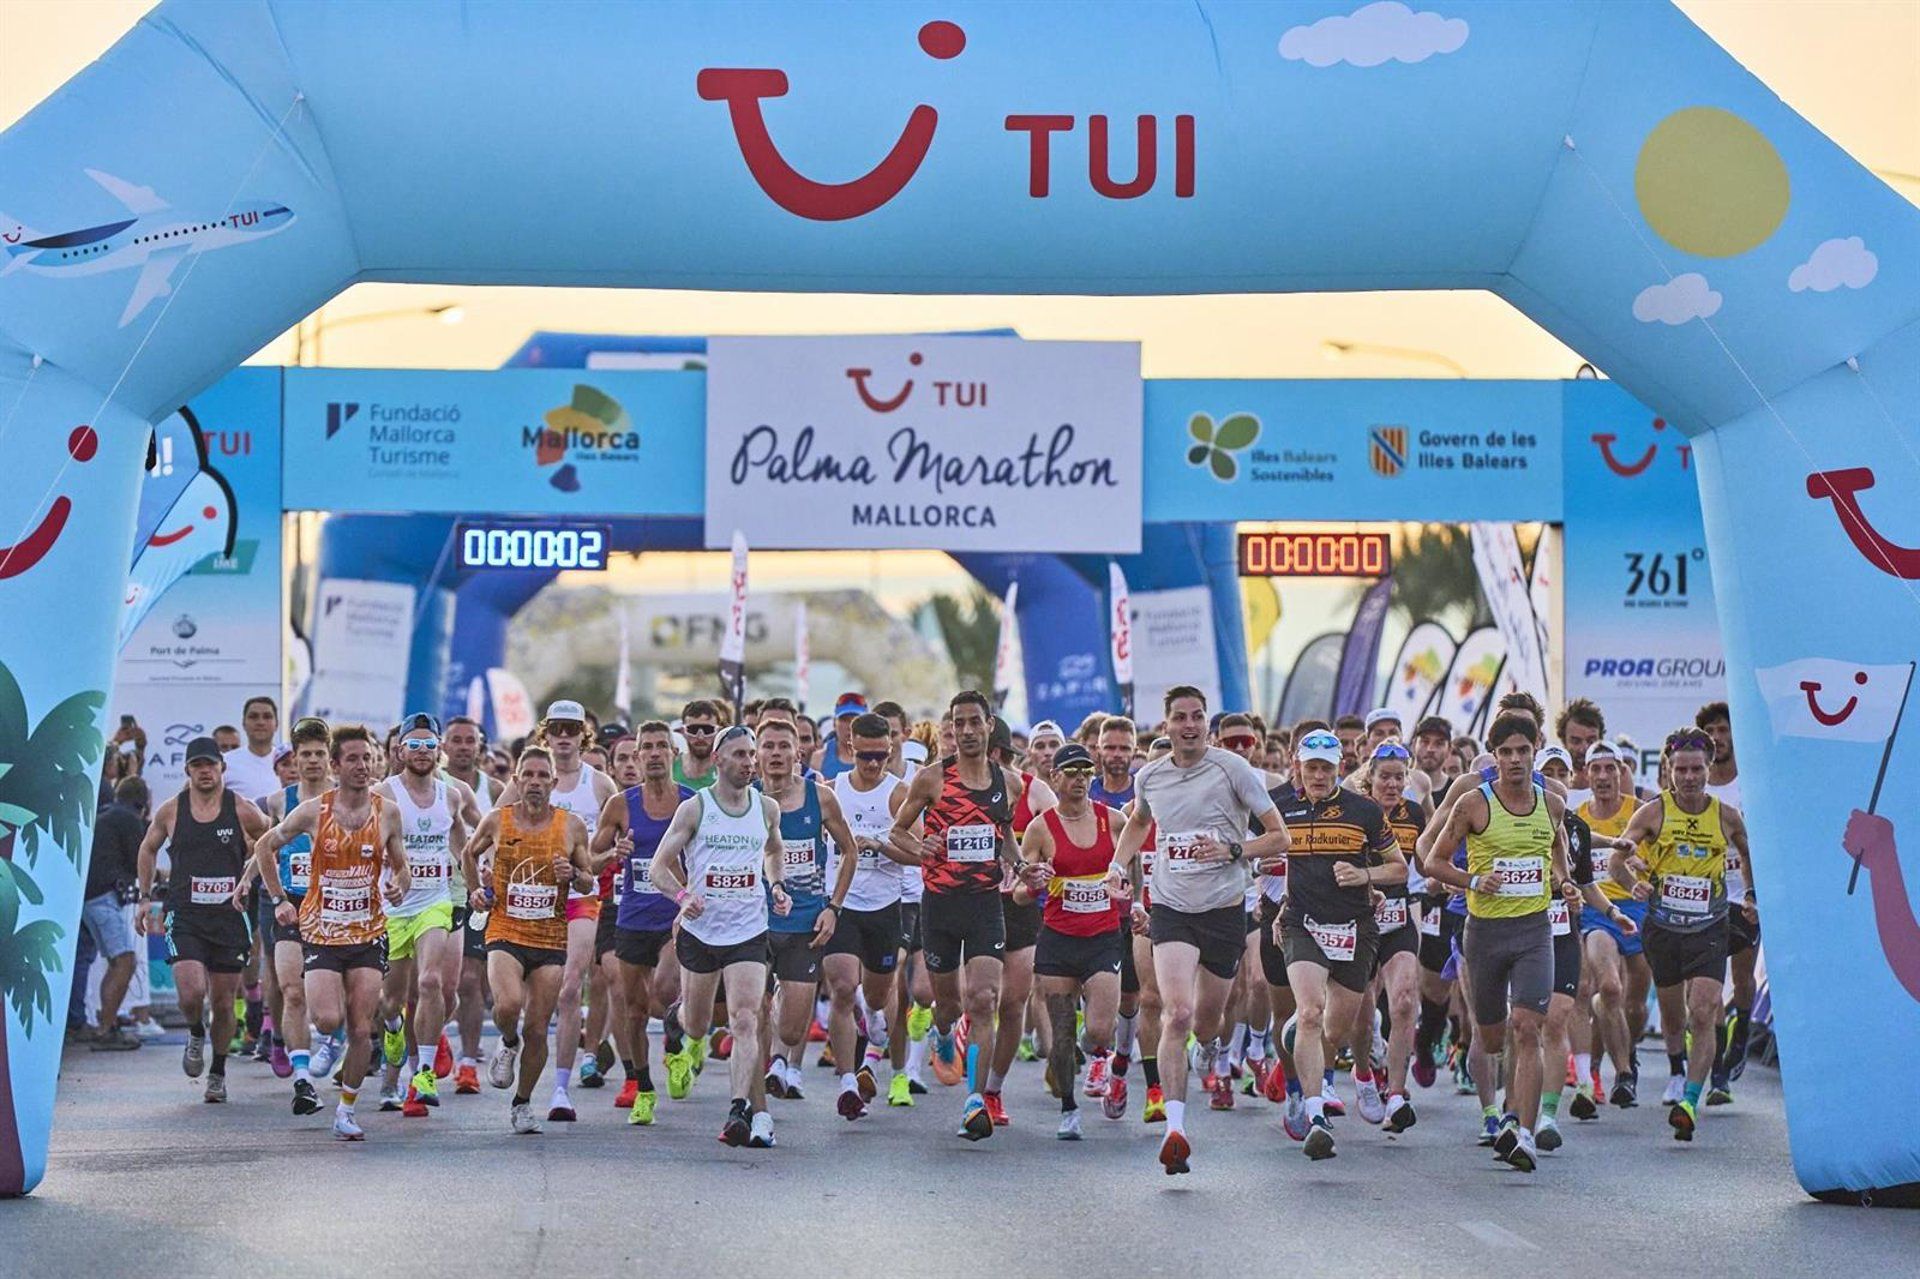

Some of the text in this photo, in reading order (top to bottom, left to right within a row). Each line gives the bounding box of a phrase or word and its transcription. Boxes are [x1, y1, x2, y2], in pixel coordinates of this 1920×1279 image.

[1005, 114, 1195, 199] TUI
[229, 211, 258, 229] TUI
[934, 381, 988, 407] TUI
[369, 402, 461, 422] Fundació
[369, 425, 455, 443] Mallorca
[522, 426, 640, 450] Mallorca
[1419, 430, 1537, 448] Govern de les
[203, 432, 251, 456] TUI
[369, 446, 451, 466] Turisme
[730, 423, 1119, 494] Palma Marathon
[1283, 451, 1337, 463] Balears
[1419, 453, 1528, 470] Illes Balears
[1251, 469, 1334, 482] Sostenibles
[852, 505, 997, 528] MALLORCA
[1584, 658, 1654, 677] PROA
[705, 834, 750, 844] HEATON
[954, 837, 990, 850] 1216
[296, 866, 312, 876] 26
[412, 865, 437, 877] 013
[197, 882, 230, 893] 6709
[712, 875, 749, 888] 5821
[1668, 885, 1704, 900] 6642
[328, 899, 364, 912] 4816
[513, 895, 550, 908] 5850
[1379, 911, 1400, 923] 58
[1318, 932, 1349, 947] 957
